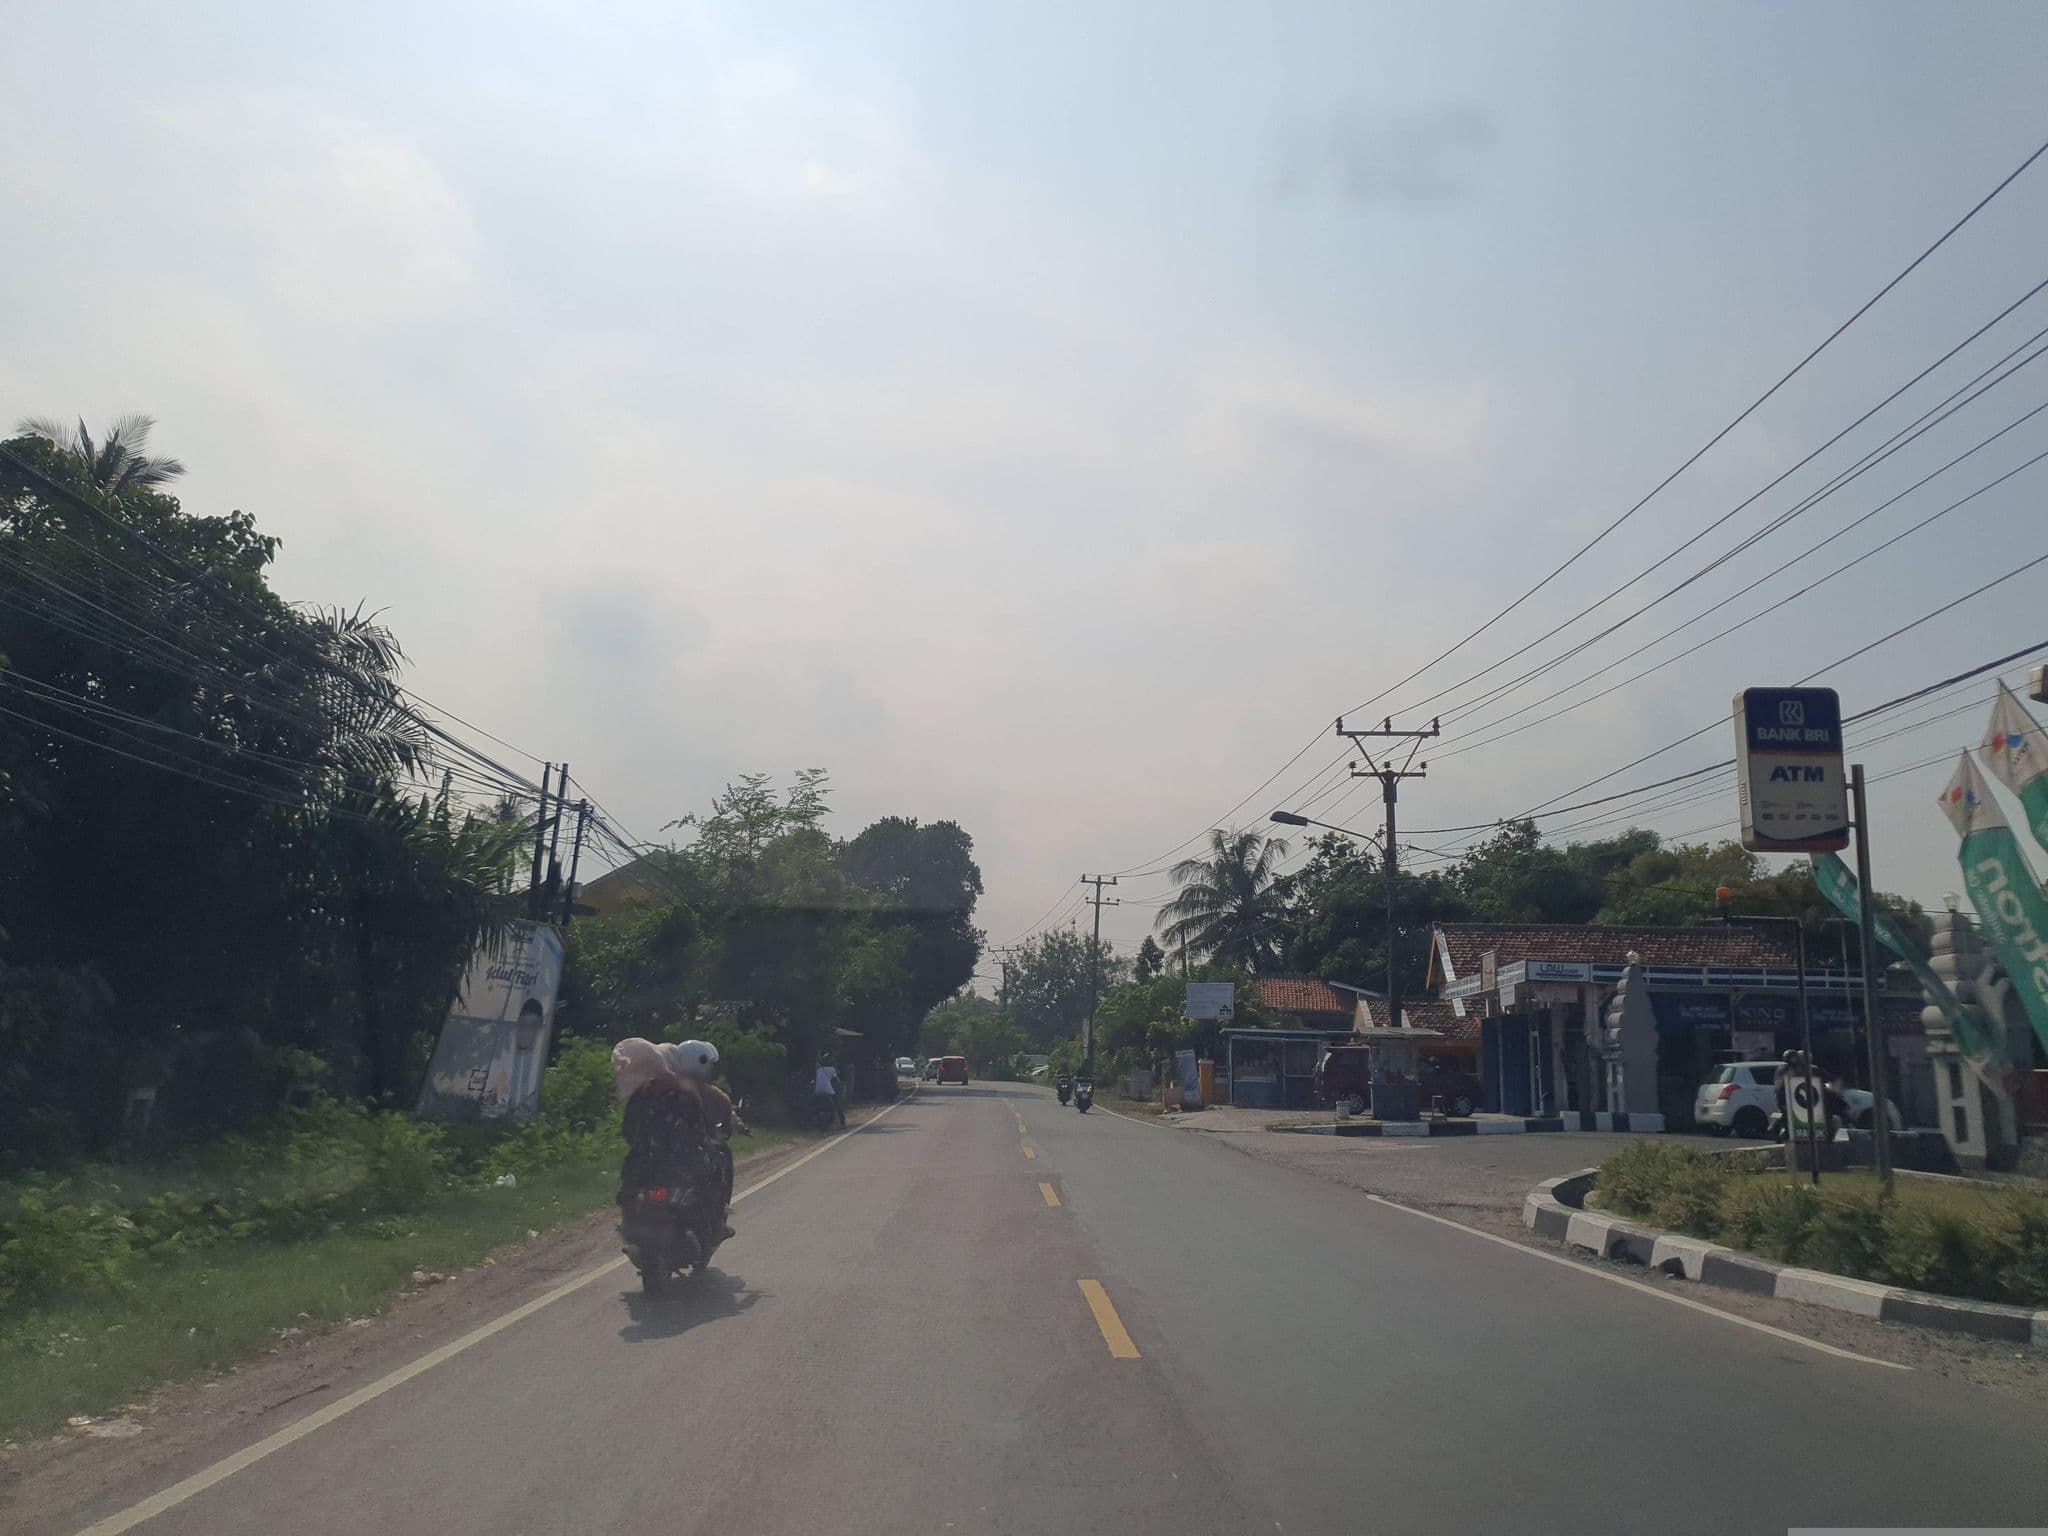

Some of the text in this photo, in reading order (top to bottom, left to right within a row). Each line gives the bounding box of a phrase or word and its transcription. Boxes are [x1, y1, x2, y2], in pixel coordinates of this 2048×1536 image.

[1757, 728, 1829, 742] BANK BRI
[1769, 766, 1825, 782] ATM
